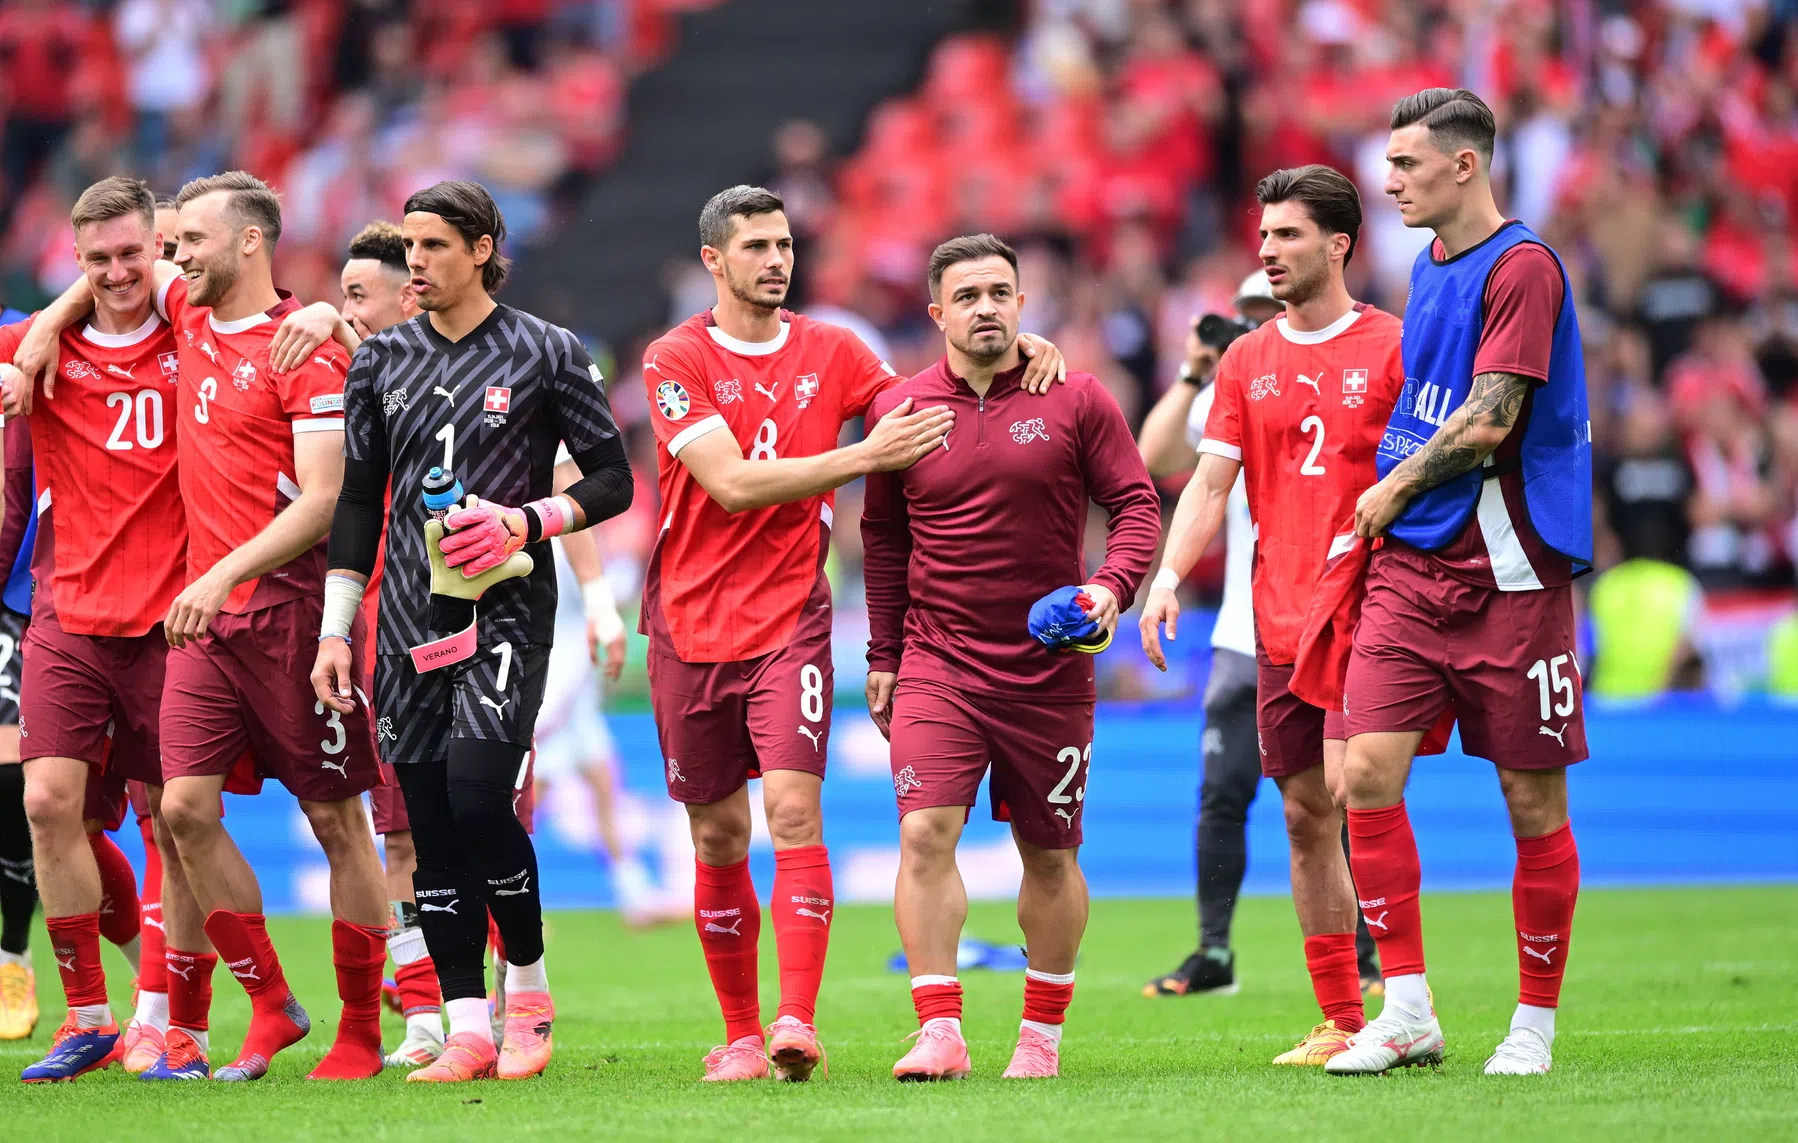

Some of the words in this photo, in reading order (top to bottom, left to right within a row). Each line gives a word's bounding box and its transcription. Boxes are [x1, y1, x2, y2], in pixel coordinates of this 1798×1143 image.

[105, 388, 164, 450] 20
[194, 377, 217, 425] 3
[435, 423, 455, 472] 1
[749, 418, 778, 460] 8
[1300, 415, 1326, 476] 2
[1379, 433, 1424, 457] SPECT
[423, 646, 458, 661] VERANO
[491, 641, 512, 692] 1
[800, 664, 824, 723] 8
[1526, 654, 1575, 721] 15
[314, 699, 347, 755] 3
[416, 888, 457, 898] SUISSE
[487, 868, 528, 886] SUISSE
[700, 908, 741, 918] SUISSE
[791, 896, 830, 907] SUISSE
[1519, 931, 1558, 943] SUISSE
